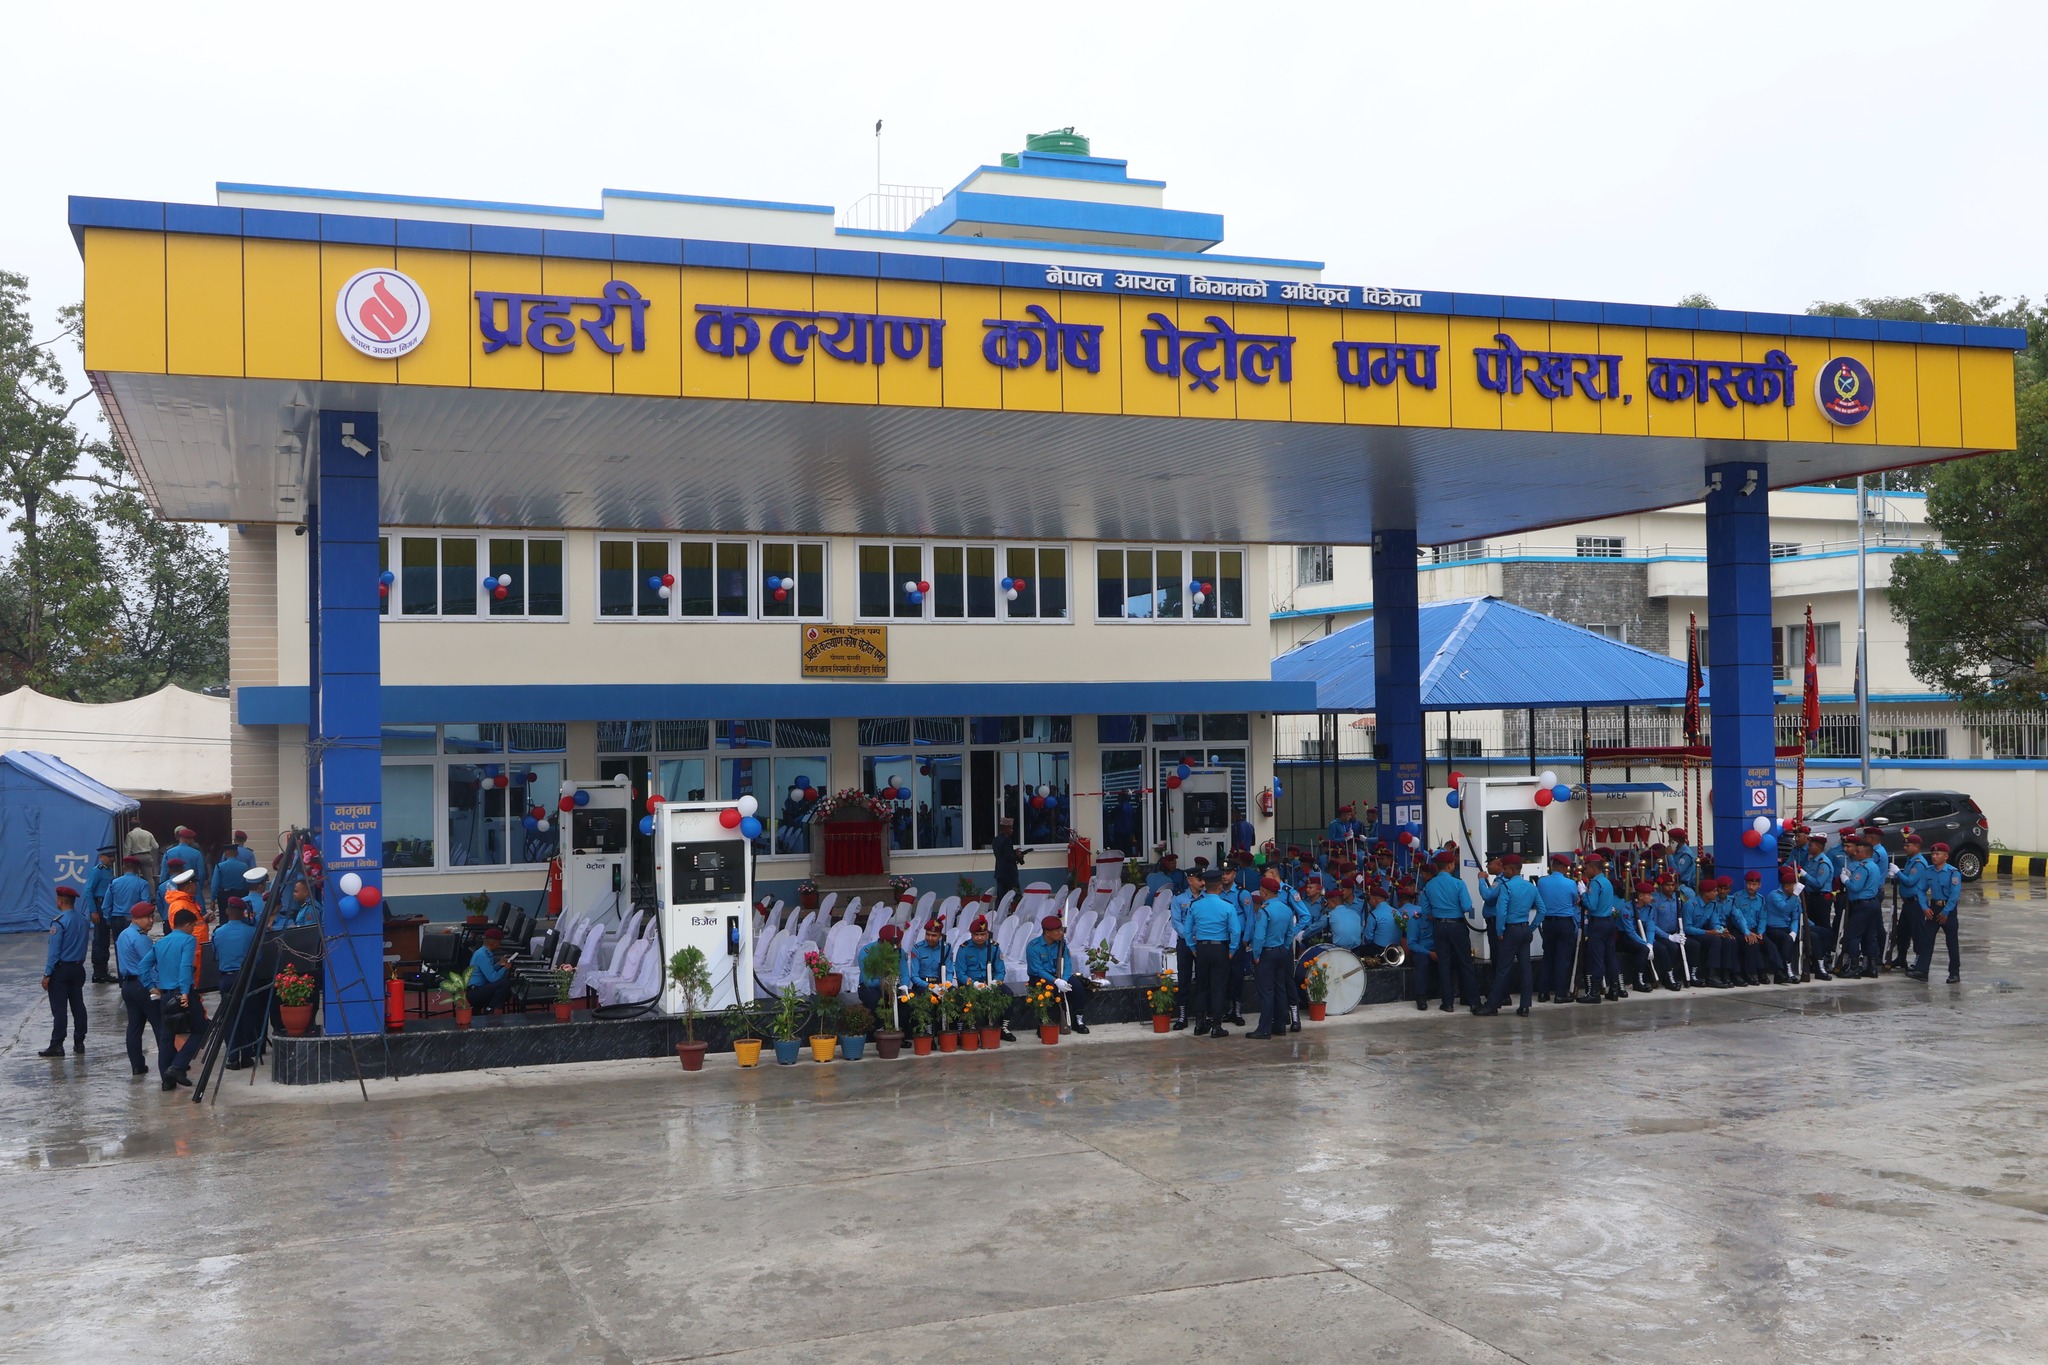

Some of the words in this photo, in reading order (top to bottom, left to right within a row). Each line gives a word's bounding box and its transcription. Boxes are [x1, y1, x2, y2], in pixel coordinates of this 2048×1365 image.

[1045, 265, 1104, 288] नेपाल
[1115, 273, 1177, 293] आयल
[1189, 275, 1270, 299] निगमको
[1280, 281, 1351, 306] अधिकृत
[1362, 285, 1423, 308] विक्रेता
[373, 346, 396, 354] आयल
[473, 279, 651, 355] प्रहरी
[694, 303, 947, 369] कल्याण
[981, 304, 1104, 374] कोष
[1140, 312, 1297, 393] पेट्रोल
[1332, 341, 1441, 391] पम्प
[1648, 349, 1798, 409] कास्की
[804, 644, 821, 661] प्रहरी
[818, 637, 843, 651] कल्याण
[844, 635, 857, 648] कोष
[335, 805, 371, 819] नमूना
[330, 821, 354, 832] पेट्रोल
[53, 850, 89, 884] 灾
[586, 862, 606, 871] पेट्रोल
[691, 915, 718, 927] डिजेल
